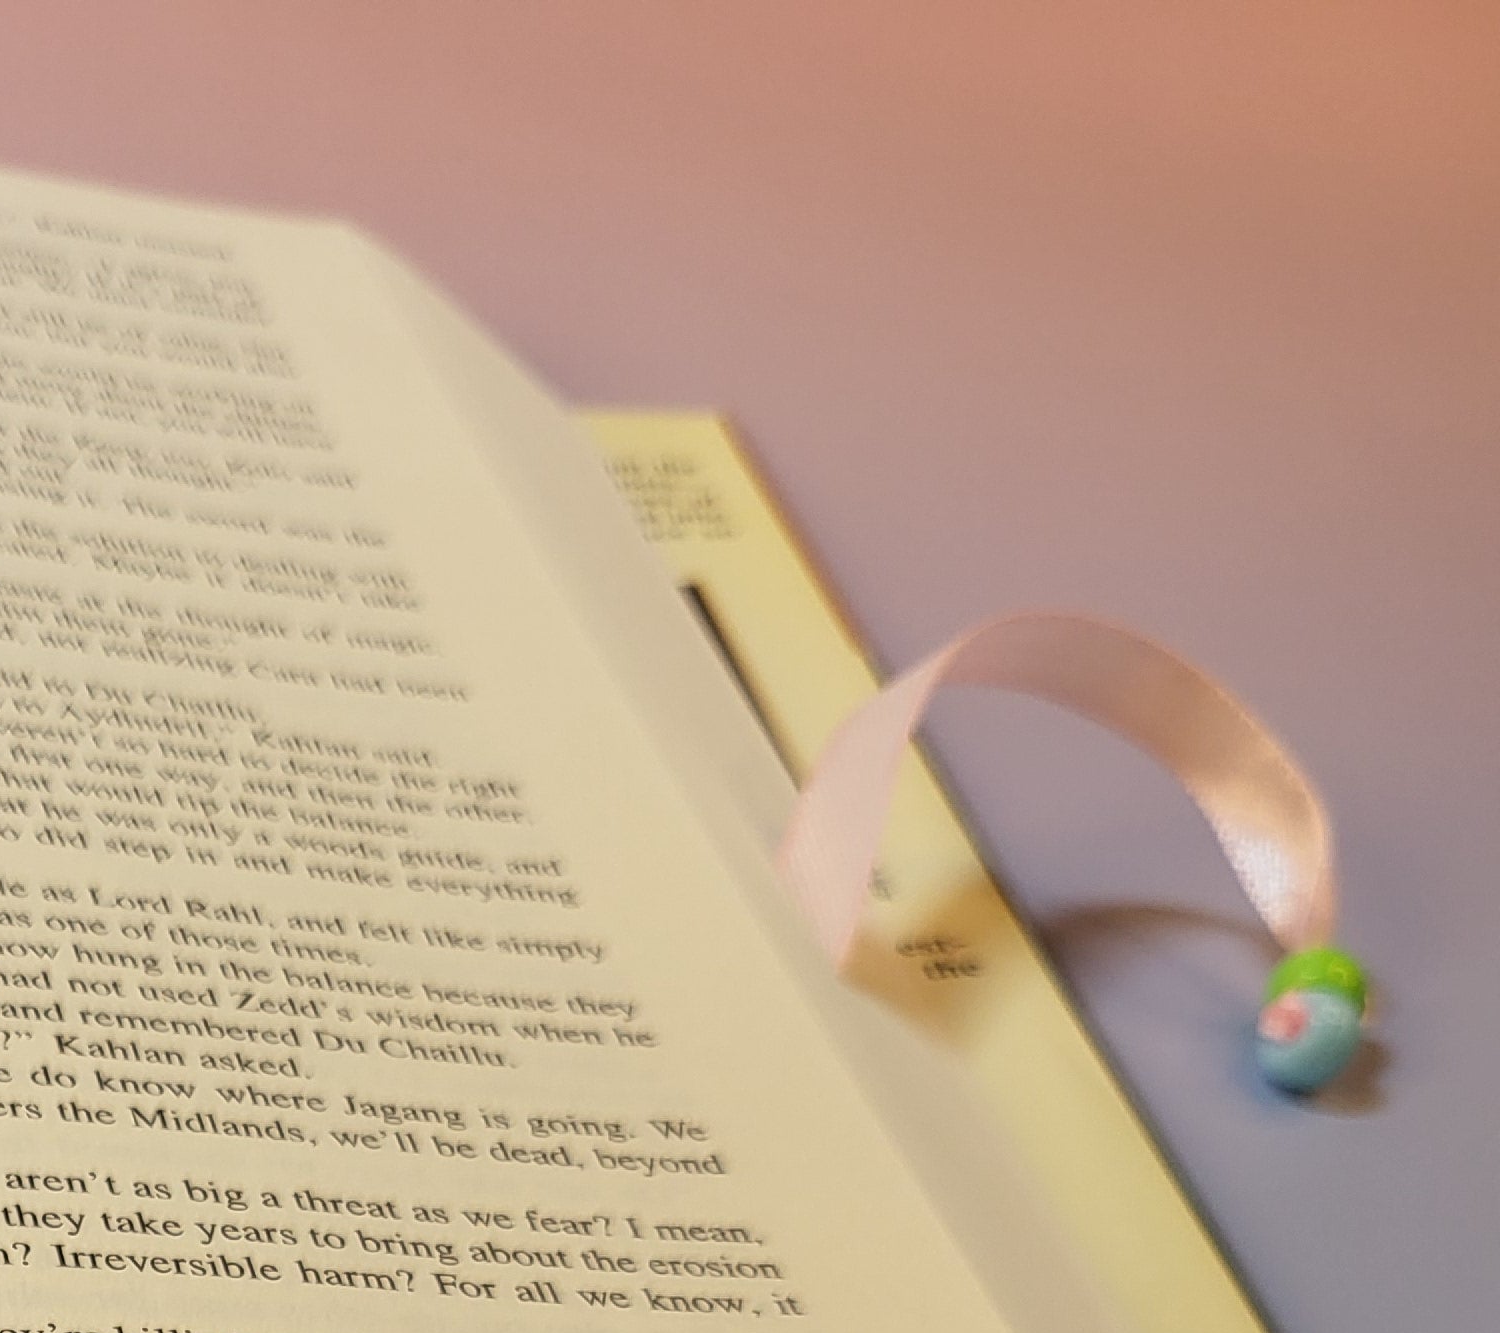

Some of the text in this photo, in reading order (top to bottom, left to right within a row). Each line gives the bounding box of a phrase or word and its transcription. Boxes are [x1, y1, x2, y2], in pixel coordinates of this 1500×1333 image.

[68, 977, 125, 999] not
[367, 1009, 501, 1037] wisdom
[54, 1033, 186, 1067] Kahlan
[200, 1051, 314, 1081] asked.
[30, 1066, 77, 1089] do
[97, 1070, 196, 1100] know
[216, 1086, 326, 1114] where
[343, 1094, 467, 1130] Jagang
[481, 1109, 509, 1130] is
[528, 1117, 636, 1142] going.
[649, 1119, 709, 1141] We
[2, 1204, 86, 1236] they
[101, 1210, 184, 1237] take
[196, 1221, 299, 1245] years
[311, 1229, 346, 1250] to
[357, 1230, 460, 1265] bring
[469, 1242, 573, 1270] about
[582, 1248, 637, 1274] the
[648, 1255, 783, 1280] erosion
[133, 1179, 172, 1199] as
[184, 1179, 249, 1211] big
[261, 1190, 282, 1209] a
[294, 1190, 400, 1220] threat
[412, 1205, 450, 1224] as
[464, 1209, 513, 1231] we
[526, 1210, 612, 1236] fear?
[627, 1216, 643, 1240] I
[655, 1224, 764, 1246] mean,
[51, 1243, 282, 1281] Irreversible
[298, 1261, 416, 1293] harm?
[432, 1272, 497, 1299] For
[516, 1282, 563, 1305] all
[578, 1290, 631, 1309] we
[643, 1288, 761, 1317] know,
[774, 1294, 804, 1317] it
